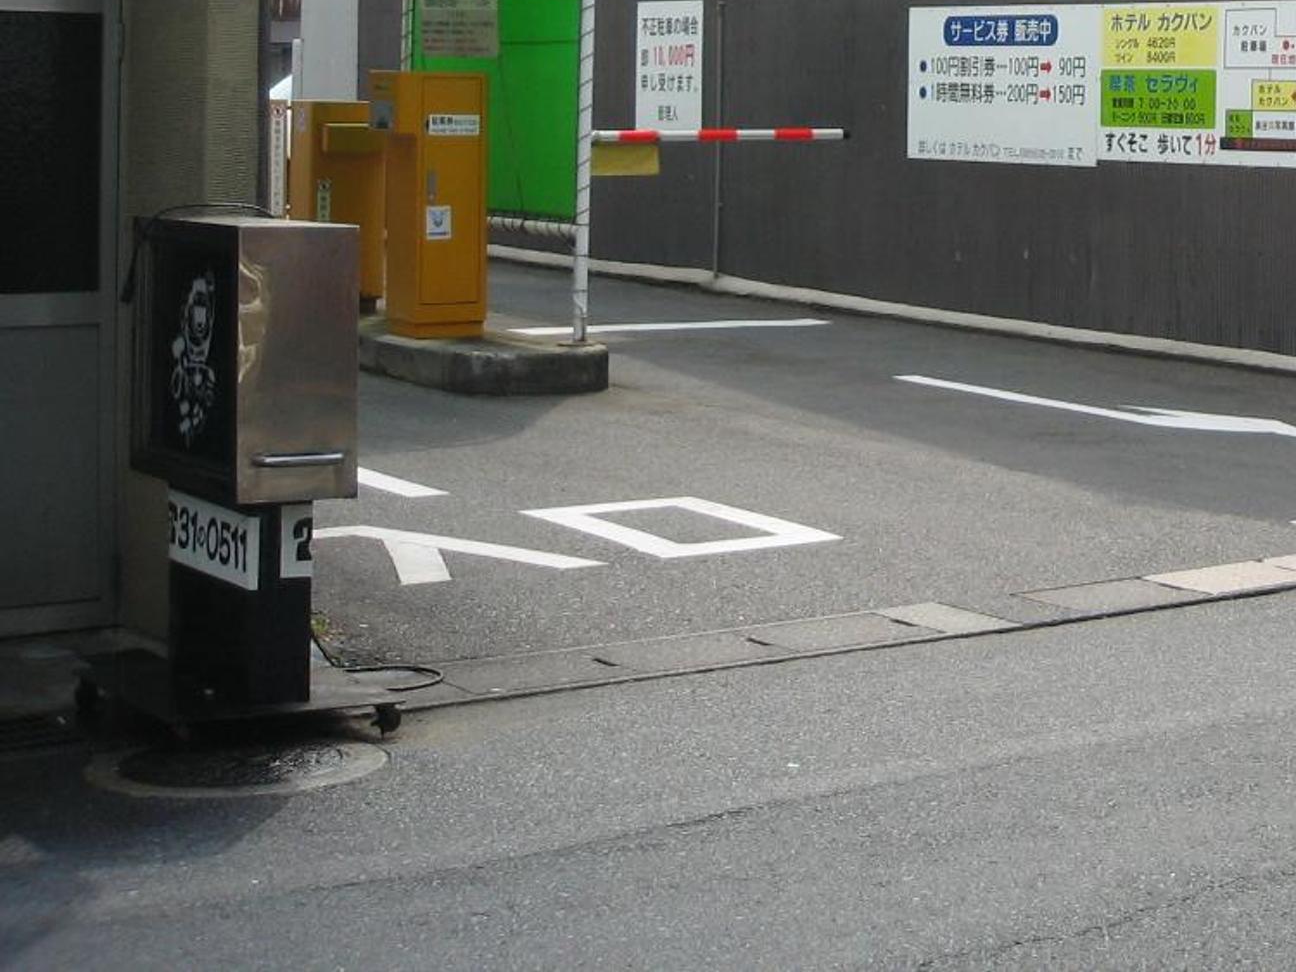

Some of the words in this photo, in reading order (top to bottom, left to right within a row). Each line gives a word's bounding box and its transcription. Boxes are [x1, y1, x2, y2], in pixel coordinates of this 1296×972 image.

[1111, 13, 1151, 31] ホテル
[1157, 12, 1212, 31] カクバン
